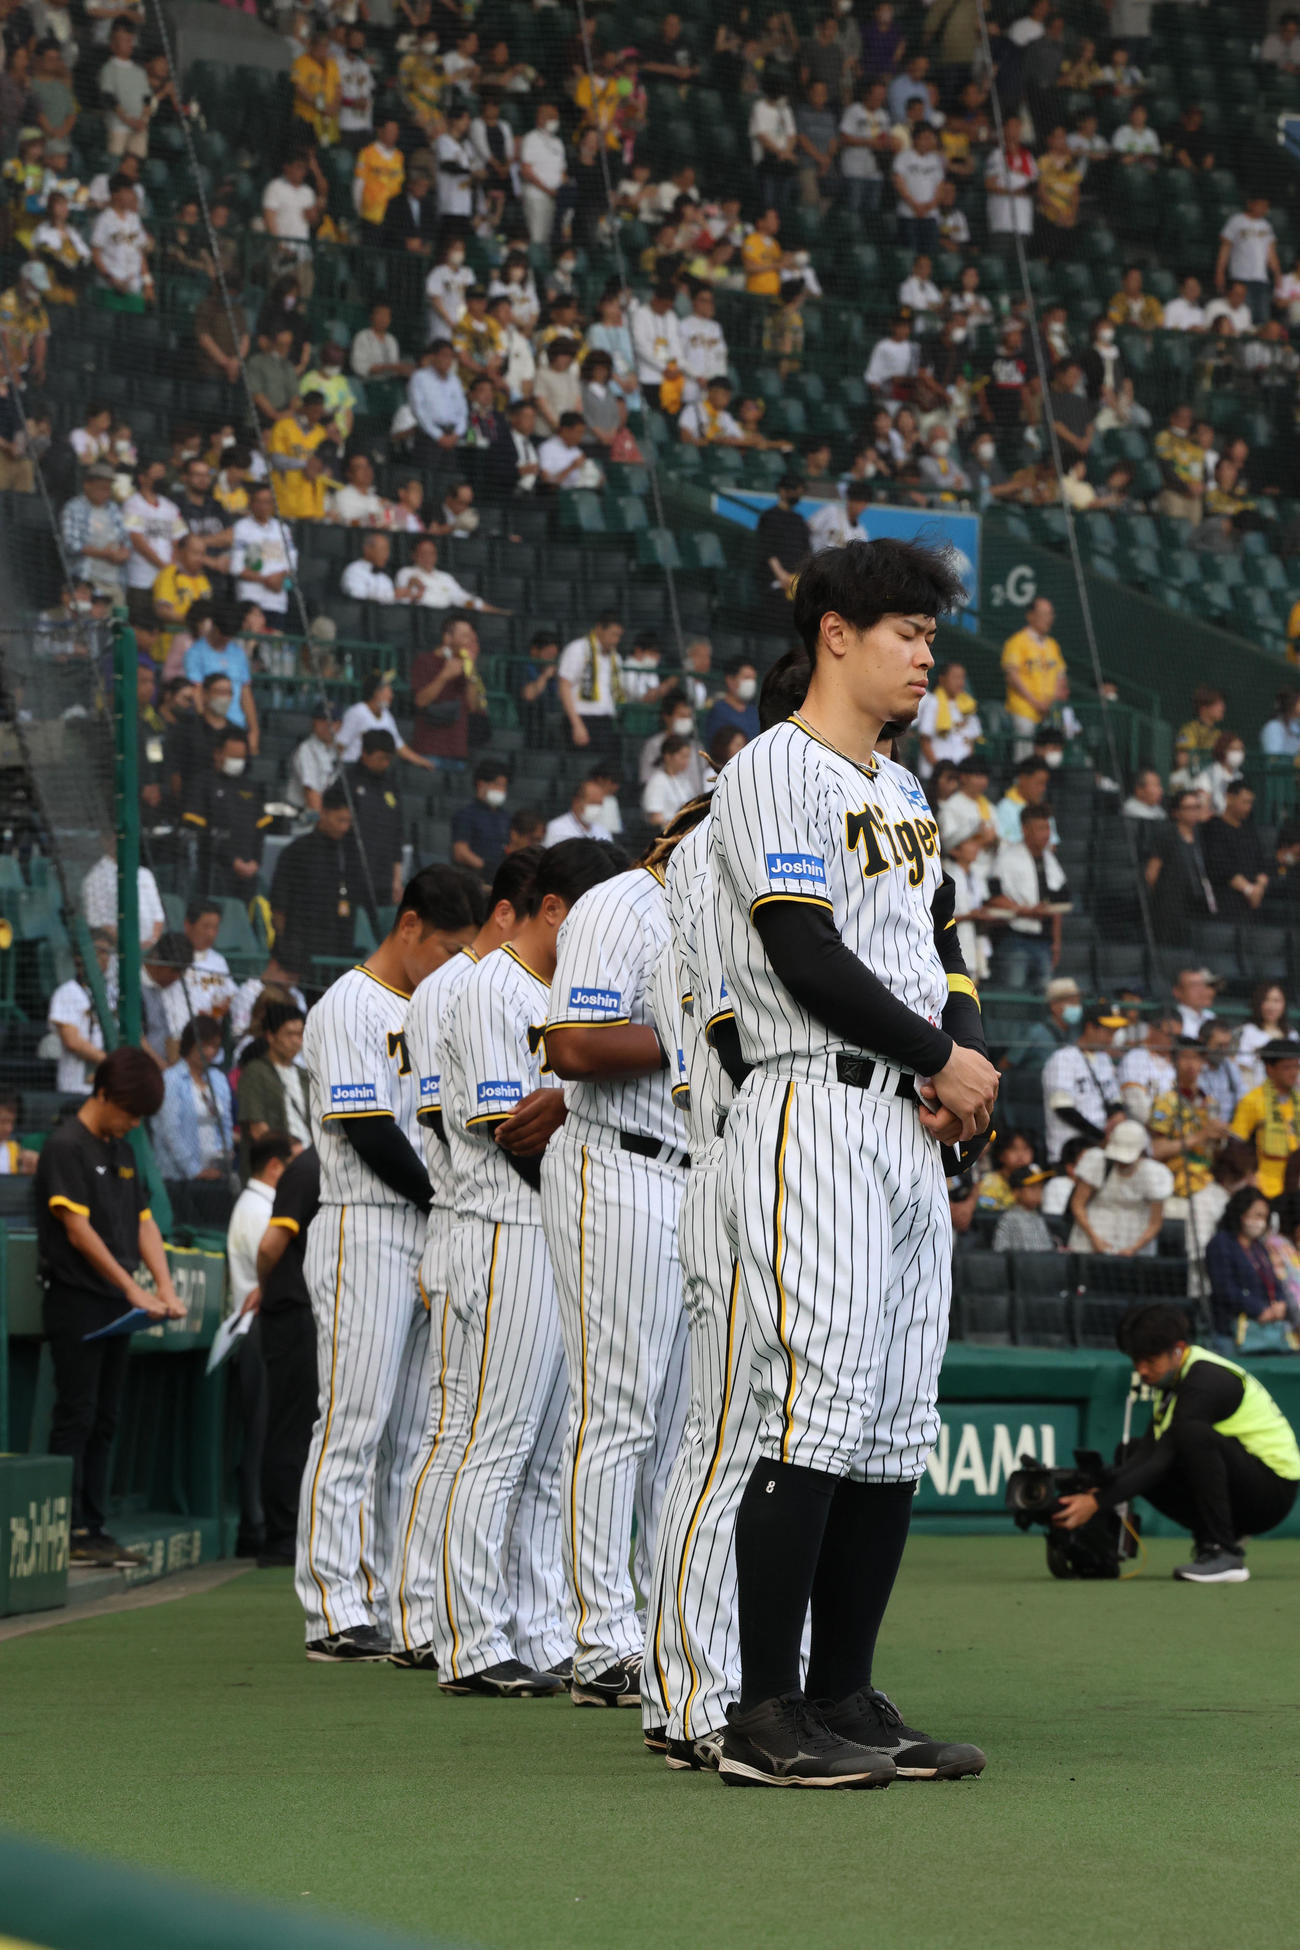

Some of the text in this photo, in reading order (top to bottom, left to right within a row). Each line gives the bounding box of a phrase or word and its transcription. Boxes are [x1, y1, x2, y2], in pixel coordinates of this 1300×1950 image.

[770, 858, 824, 879] Joshin
[571, 991, 618, 1008] Joshin
[333, 1085, 374, 1100] Joshin
[422, 1080, 441, 1092] Jo
[478, 1082, 520, 1098] Joshin
[765, 1480, 776, 1494] 8
